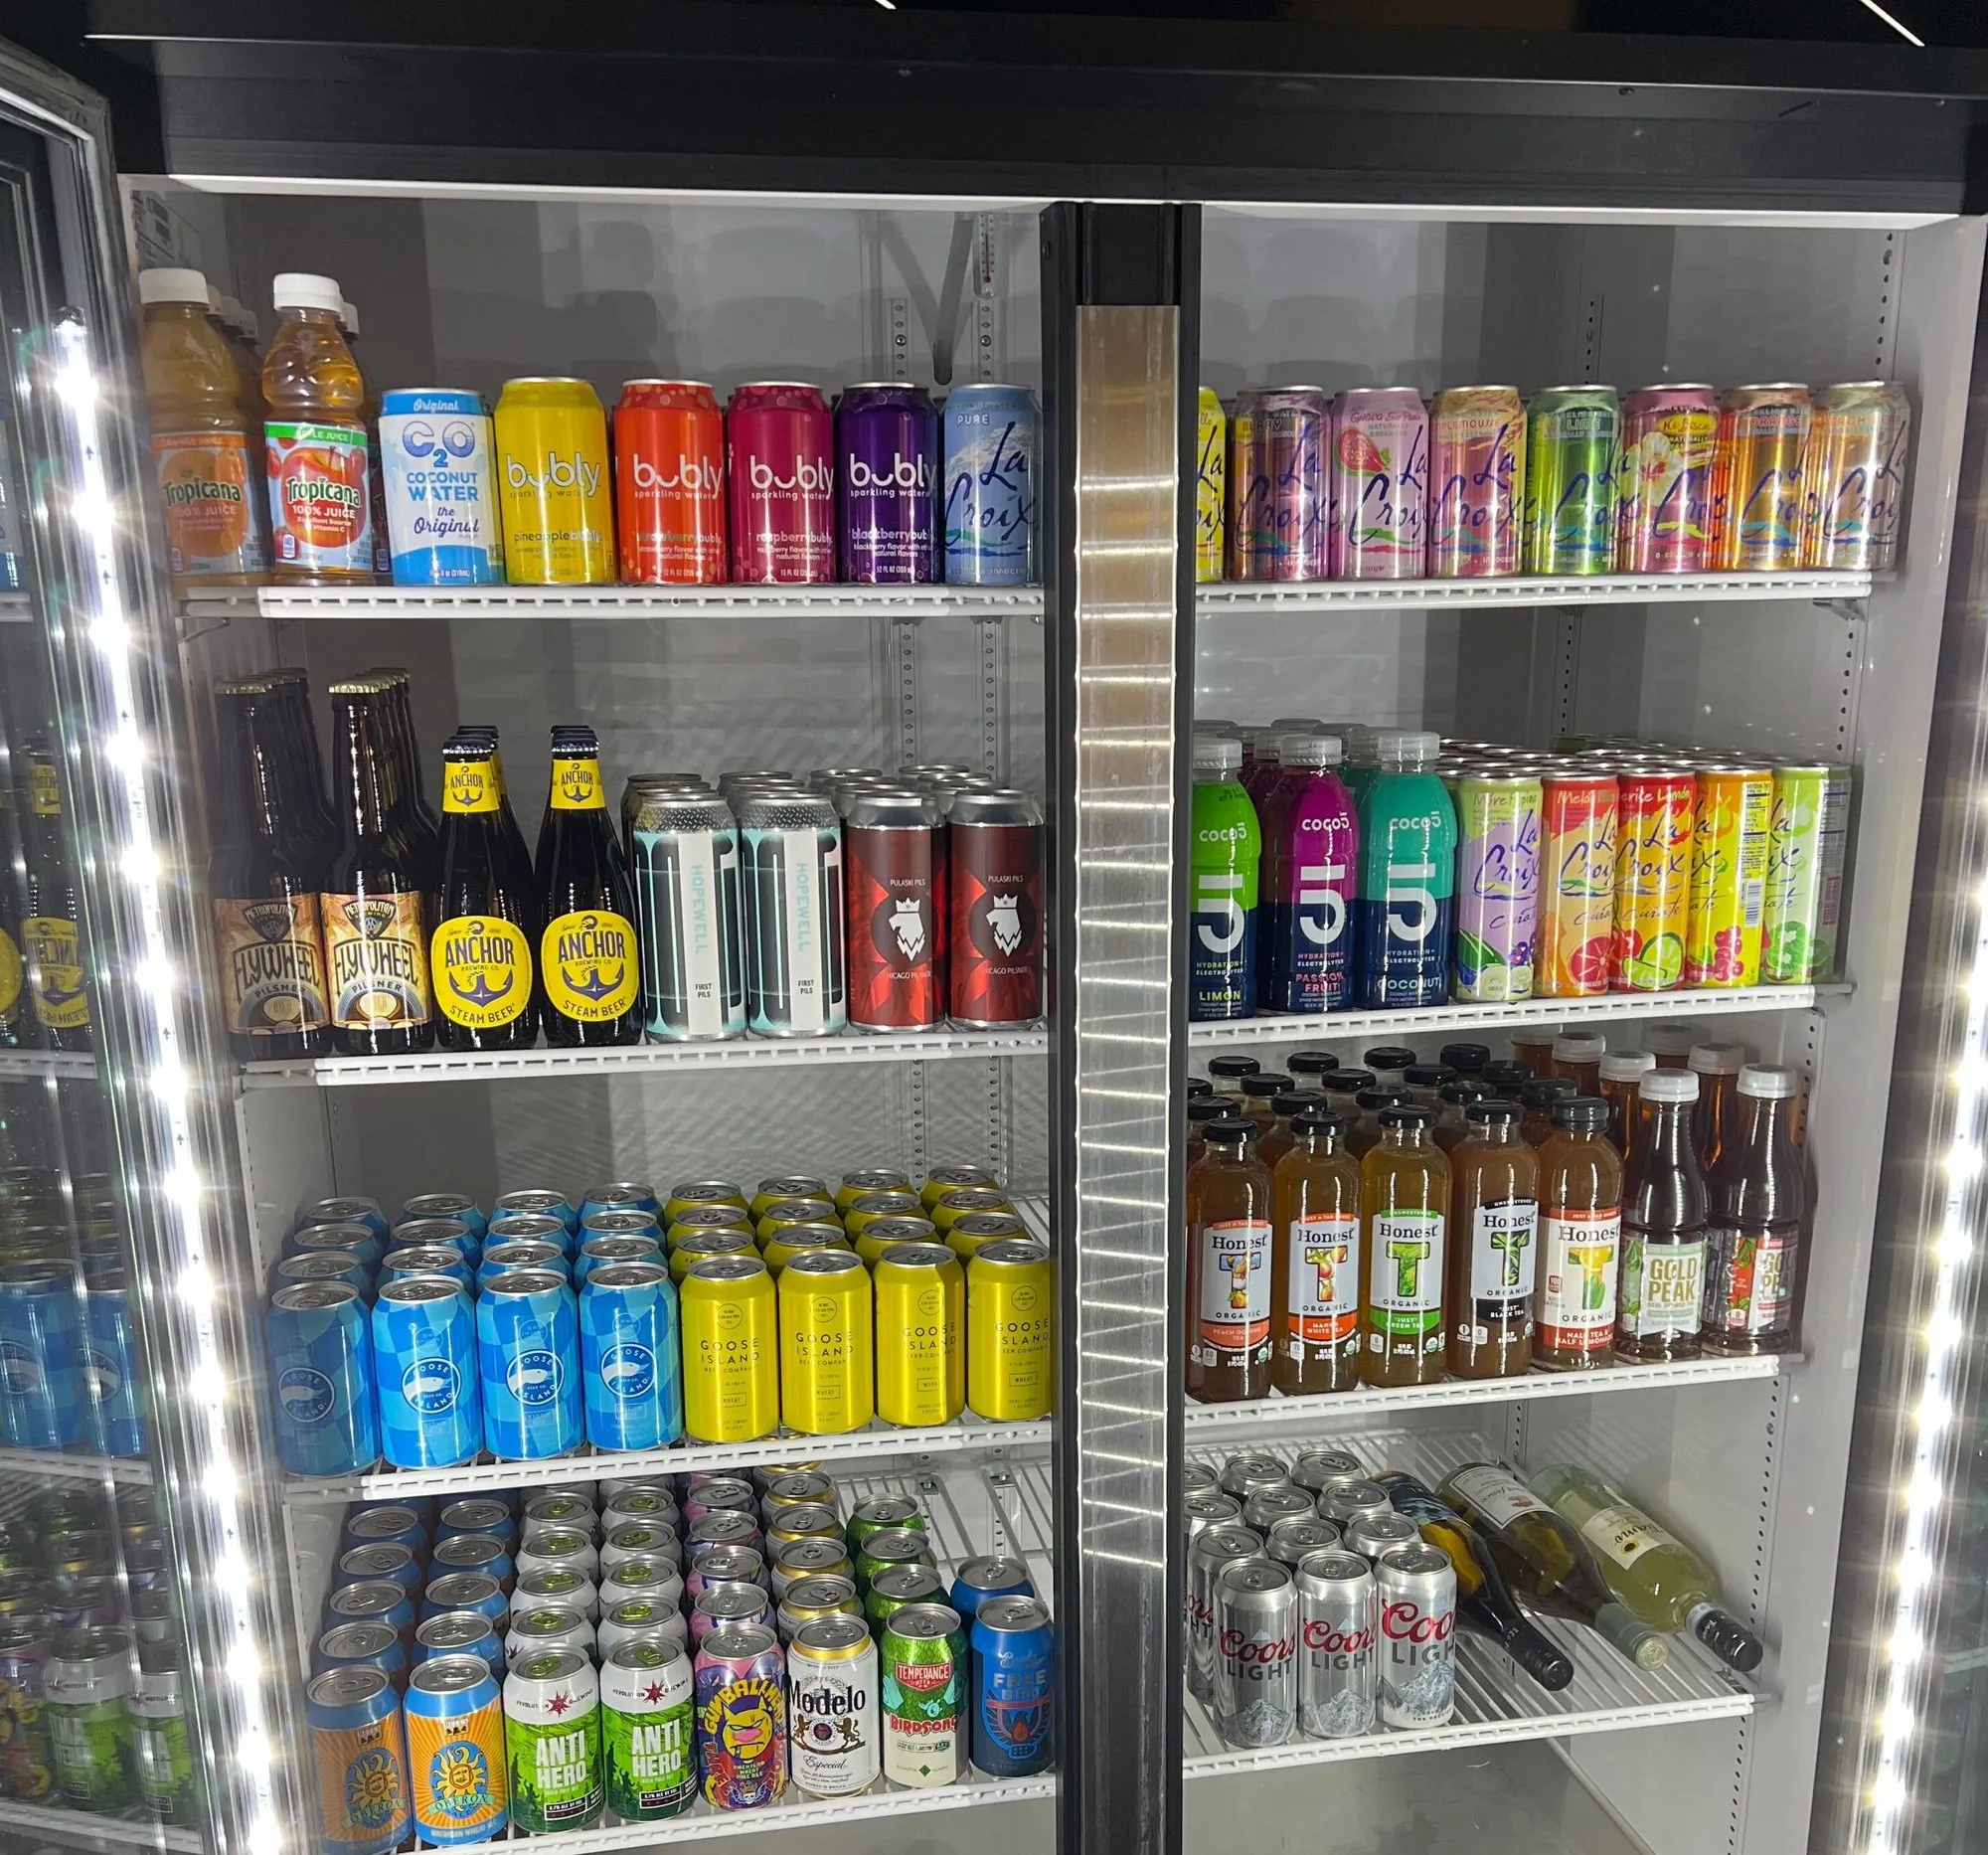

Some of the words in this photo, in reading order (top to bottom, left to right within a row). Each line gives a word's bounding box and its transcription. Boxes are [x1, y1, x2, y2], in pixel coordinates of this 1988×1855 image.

[413, 399, 459, 413] Original
[955, 413, 990, 425] PURE
[407, 471, 479, 484] COCONUT
[506, 451, 600, 498] bubly
[633, 453, 723, 500] bubly
[750, 454, 834, 501] bubly
[850, 452, 937, 498] bubly
[163, 481, 242, 507] Tropicana
[286, 477, 361, 509] Tropicana
[409, 485, 480, 502] WATER
[750, 490, 798, 502] sparkling
[850, 488, 896, 498] sparkling
[899, 488, 925, 497] water
[292, 505, 321, 517] 100%
[324, 508, 356, 519] JUICE
[437, 506, 456, 518] the
[414, 518, 480, 541] Original
[450, 773, 484, 788] ANCHOR
[561, 770, 594, 786] ANCHOR
[987, 875, 1011, 884] PULASKI
[690, 864, 708, 955] HOPEWELL
[795, 862, 811, 952] HOPEWELL
[445, 936, 516, 968] ANCHOR
[559, 930, 627, 963] ANCHOR
[234, 947, 321, 1004] FLYWHEEL
[1295, 972, 1344, 983] PASSION
[254, 982, 306, 998] PILSNER
[351, 980, 402, 991] PILSNER
[695, 982, 712, 991] FIRST
[1304, 982, 1340, 992] FRUIT
[698, 990, 711, 999] PILS
[1200, 990, 1241, 1001] LIMON
[449, 1005, 485, 1024] STEAM
[488, 1007, 515, 1023] BEER
[563, 1000, 598, 1017] STEAM
[601, 1000, 626, 1016] BEER
[1297, 1226, 1355, 1244] Honest
[1379, 1223, 1438, 1239] Honest
[1558, 1225, 1619, 1242] Honest
[1212, 1233, 1268, 1251] Honest
[1649, 1257, 1697, 1280] GOLD
[1647, 1279, 1696, 1303] PEAK
[903, 1321, 955, 1337] GOOSE
[995, 1318, 1049, 1332] GOOSE
[701, 1337, 758, 1351] GOOSE
[796, 1330, 853, 1343] GOOSE
[610, 1349, 646, 1361] GOOSE
[702, 1352, 759, 1364] ISLAND
[797, 1346, 853, 1357] ISLAND
[1312, 1646, 1374, 1671] LIGHT
[898, 1663, 949, 1680] TEMPERANCE
[1227, 1659, 1292, 1682] LIGHT
[788, 1679, 867, 1717] Modelo
[632, 1718, 681, 1756] ANTI
[537, 1730, 585, 1767] ANTI
[632, 1750, 682, 1777] HERO
[803, 1755, 847, 1771] Especial
[537, 1761, 586, 1789] HERO
[435, 1793, 488, 1810] OBERON
